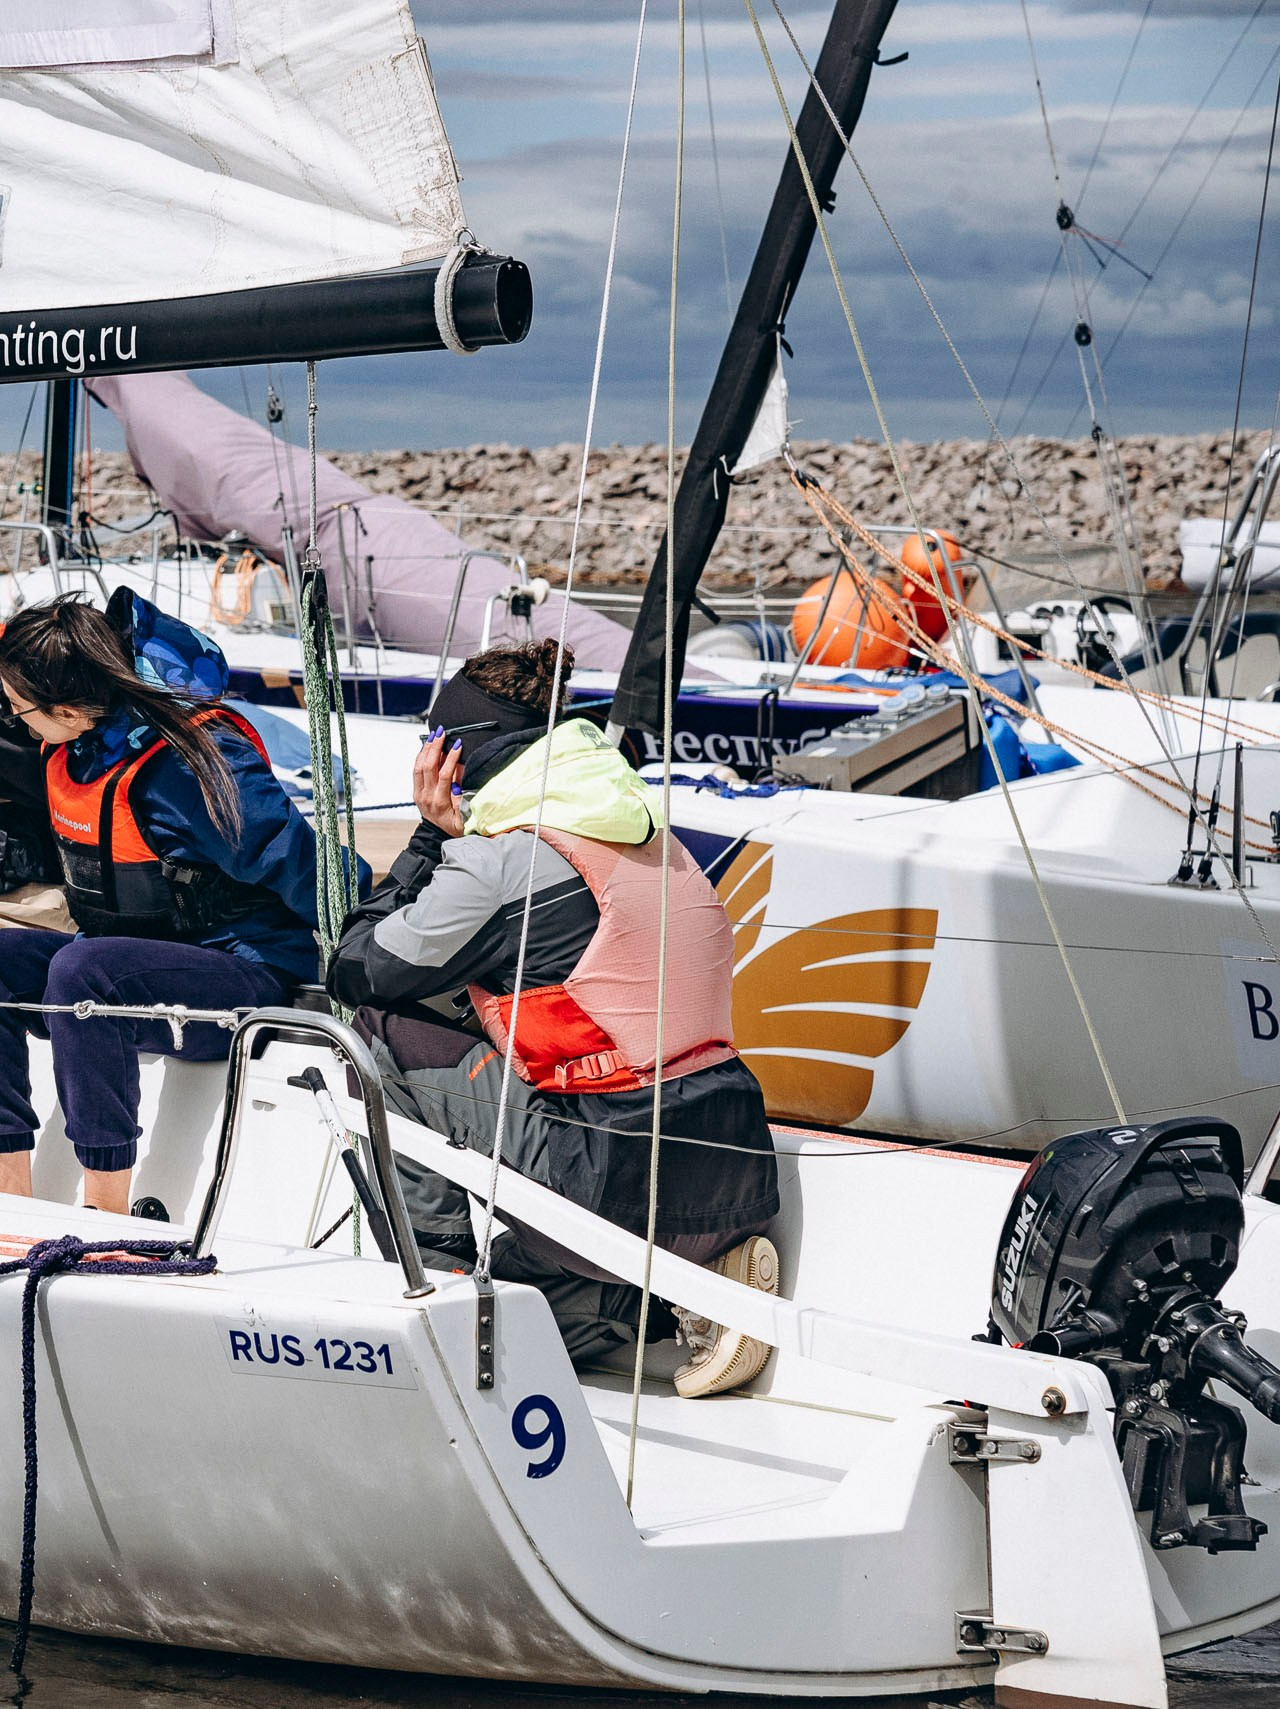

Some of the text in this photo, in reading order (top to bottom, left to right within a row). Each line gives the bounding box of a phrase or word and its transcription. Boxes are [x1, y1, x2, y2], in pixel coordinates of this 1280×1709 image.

[1001, 1193, 1039, 1312] SUZUKI
[228, 1329, 394, 1375] RUS 1231
[511, 1394, 566, 1479] 9
